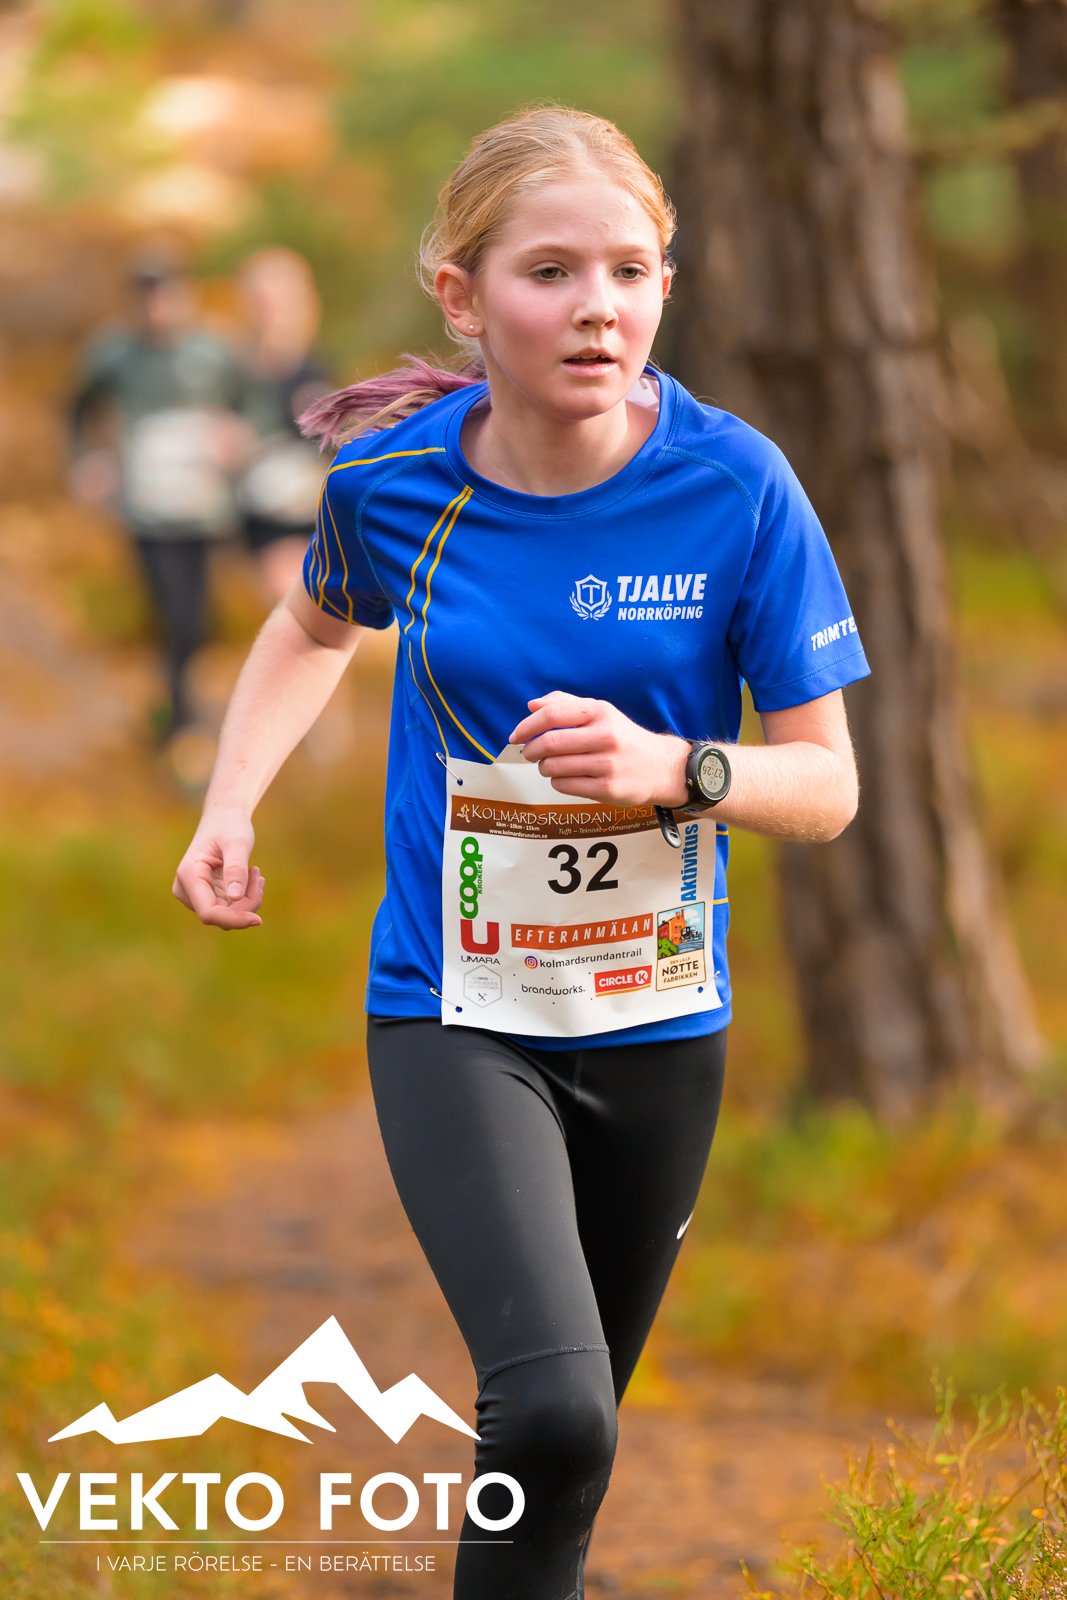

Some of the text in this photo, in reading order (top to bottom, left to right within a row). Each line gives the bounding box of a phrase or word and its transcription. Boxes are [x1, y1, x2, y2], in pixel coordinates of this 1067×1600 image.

[617, 573, 707, 602] TJALVE
[617, 603, 703, 620] NORRKÖPING
[810, 615, 858, 652] TRIMTE
[702, 765, 724, 779] 27:26
[489, 829, 548, 839] www.kolmardsrundan.se
[548, 842, 619, 894] 32
[681, 823, 698, 901] Aktivitus
[459, 836, 483, 919] coop
[515, 918, 651, 943] EFTERANMÄLAN
[461, 955, 500, 965] UMARA
[540, 948, 642, 968] kolmardsrundantrail
[662, 960, 699, 976] NØTTE
[663, 972, 698, 983] FABRIKKEN
[599, 969, 648, 988] CIRCLE K
